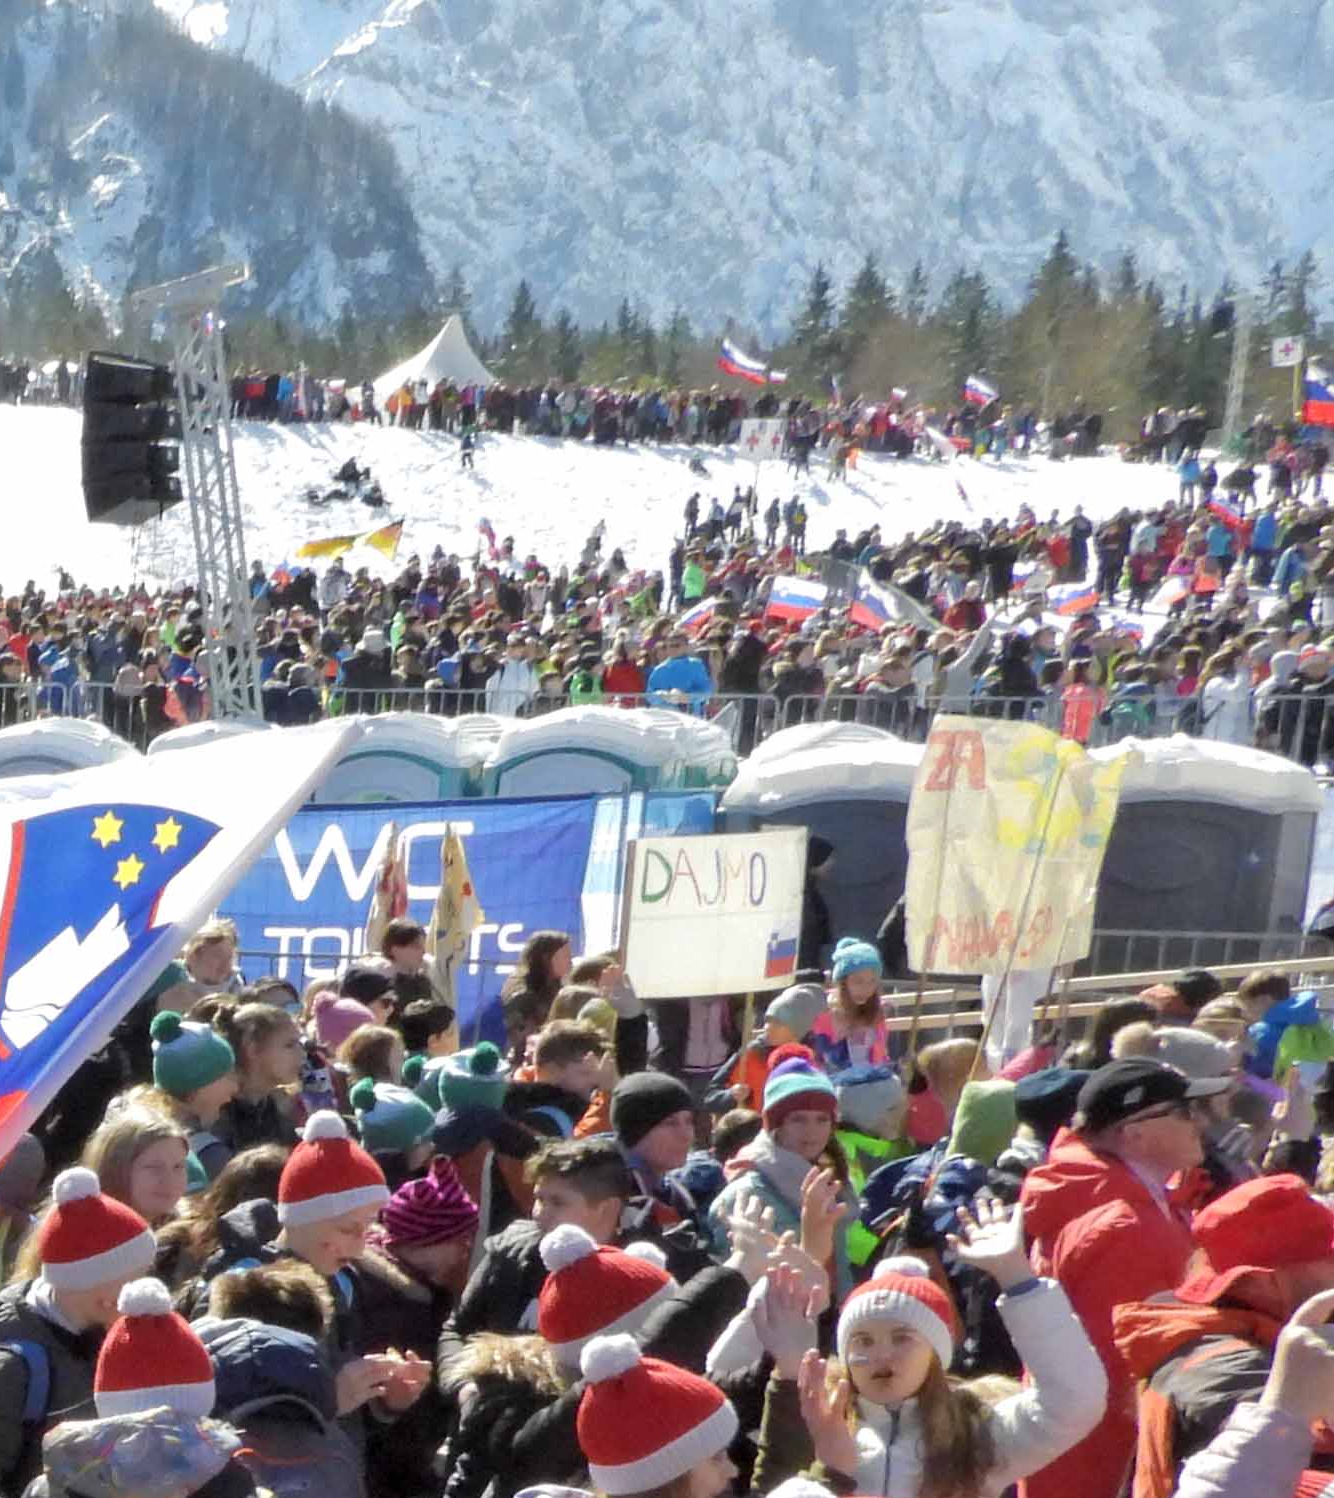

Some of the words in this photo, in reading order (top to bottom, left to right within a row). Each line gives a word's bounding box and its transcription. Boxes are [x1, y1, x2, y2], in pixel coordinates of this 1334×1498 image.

[274, 821, 475, 901] WC
[641, 848, 766, 908] DAJMO
[264, 923, 526, 980] TOITS
